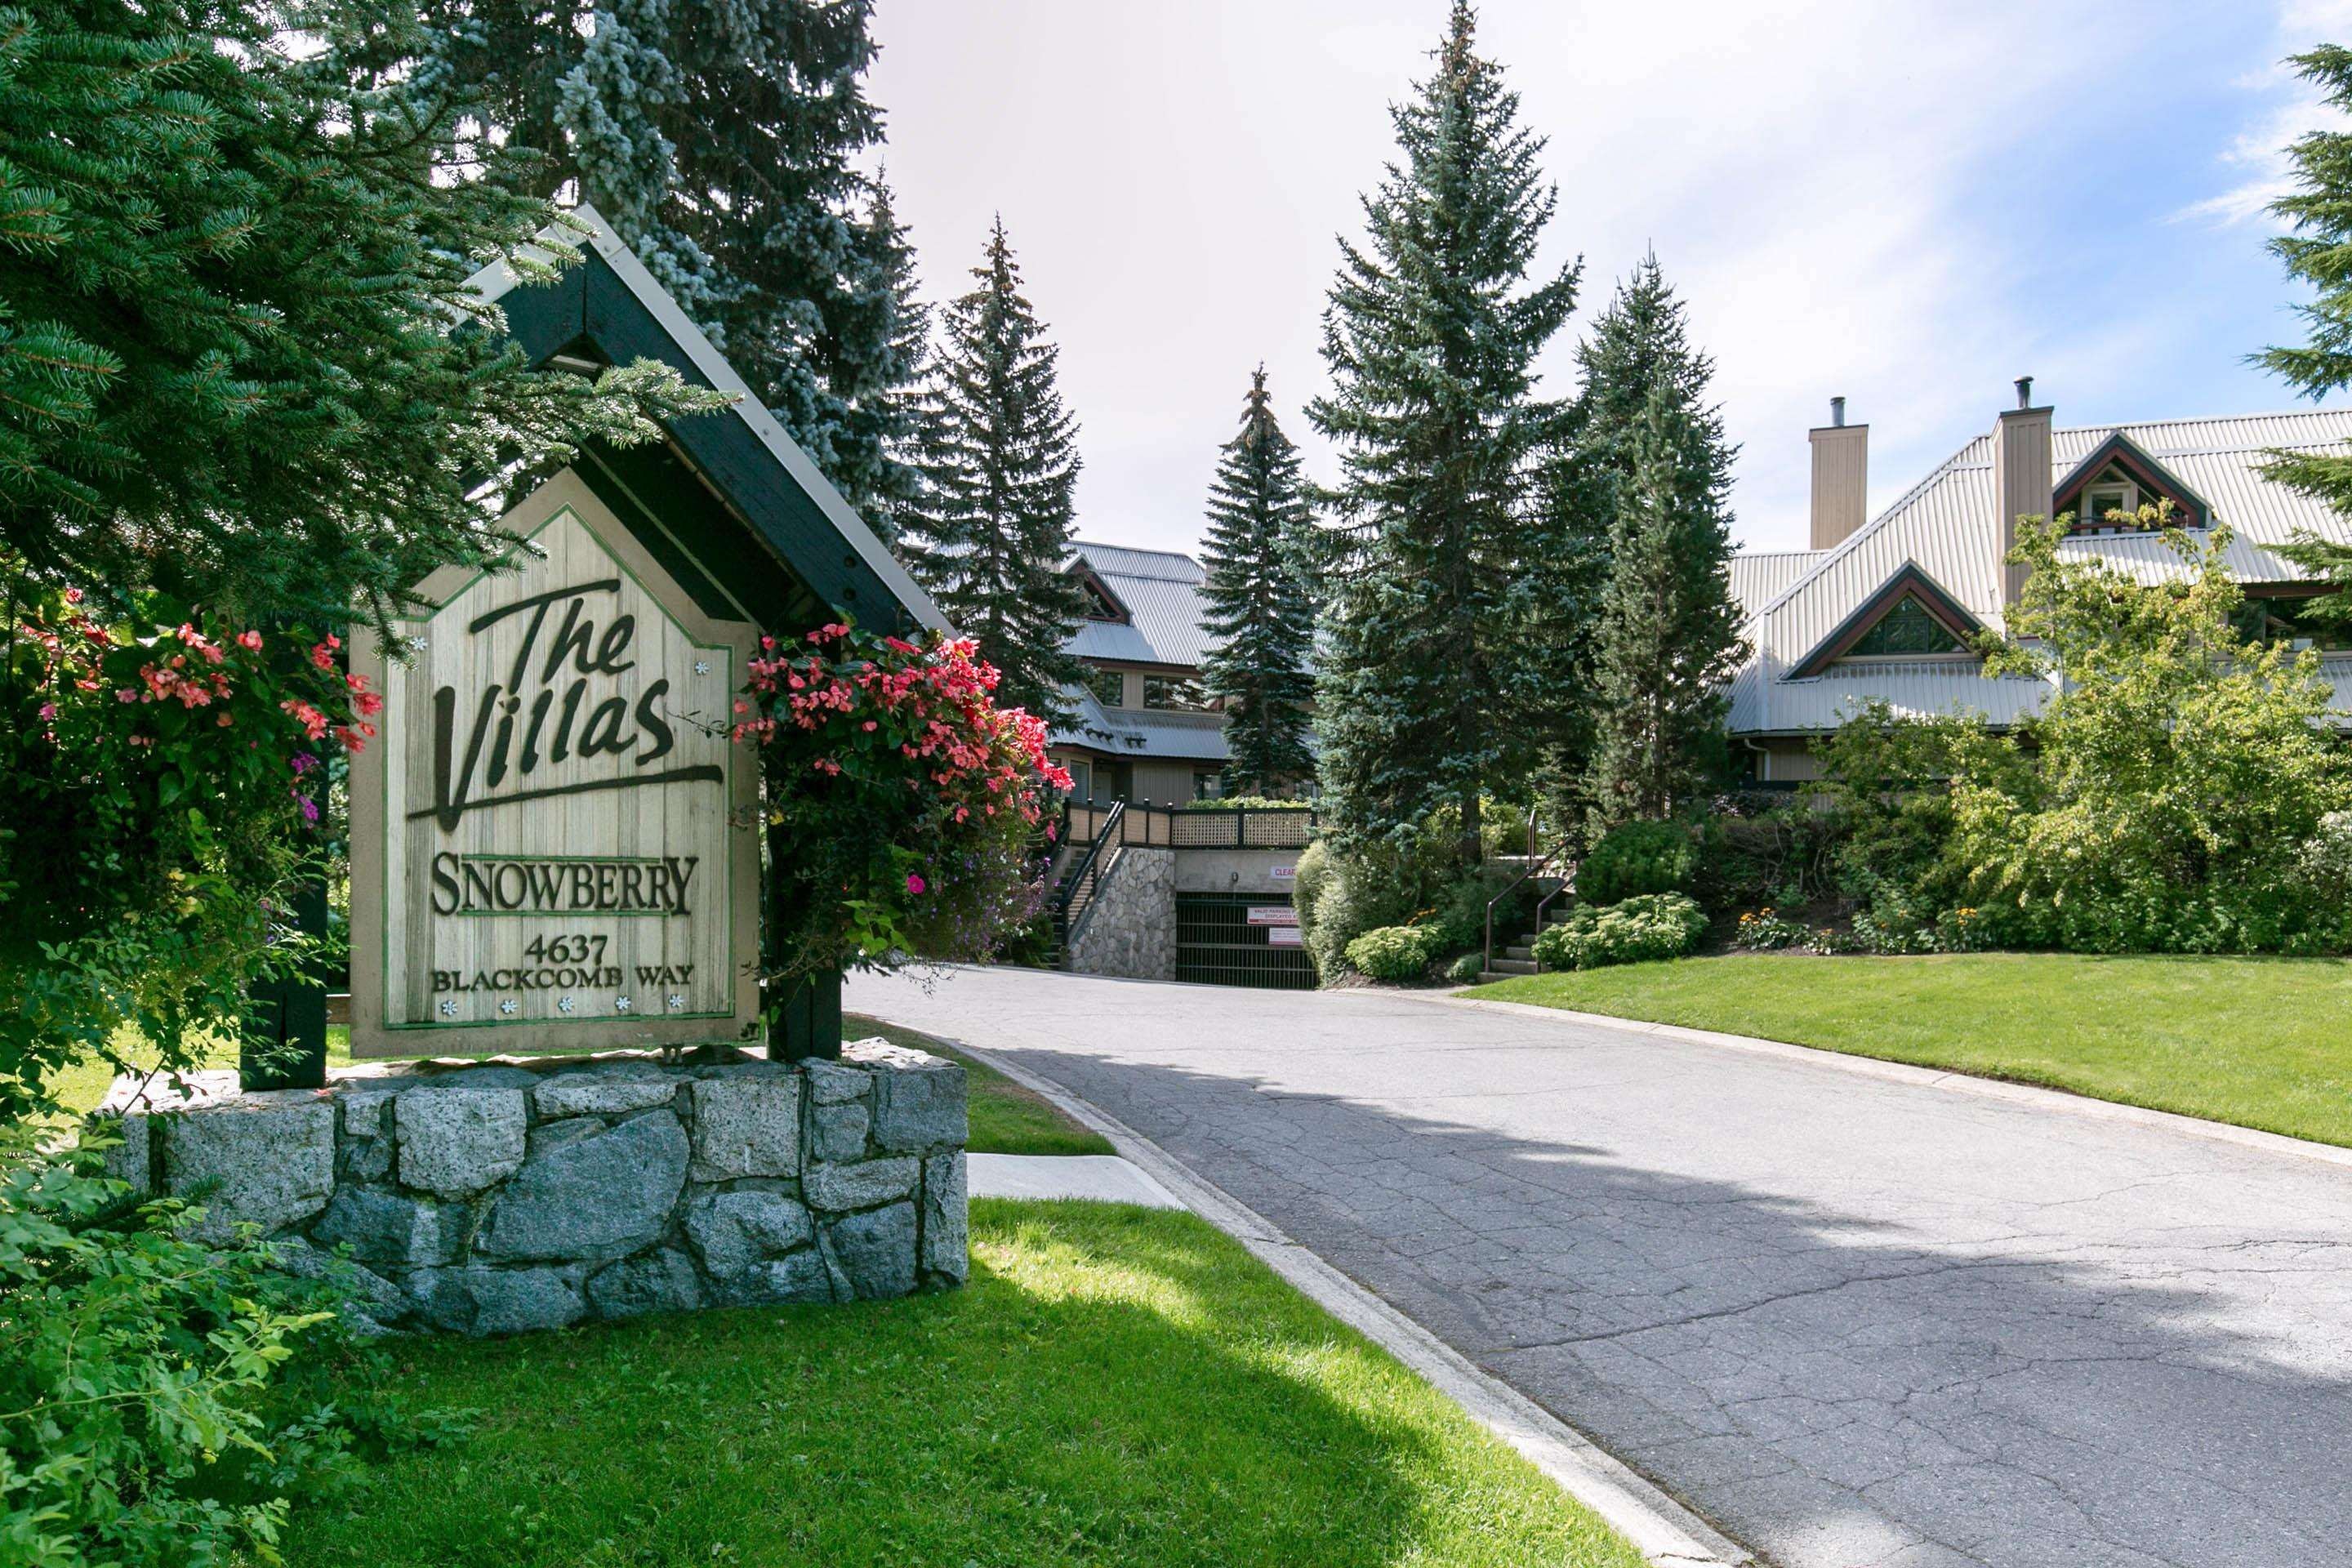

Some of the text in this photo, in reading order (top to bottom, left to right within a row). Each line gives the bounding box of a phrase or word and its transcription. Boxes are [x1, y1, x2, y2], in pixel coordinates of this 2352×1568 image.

[470, 578, 635, 693] The
[434, 678, 674, 833] Villas
[431, 852, 698, 915] SNOWBERRY
[432, 964, 694, 991] BLACKCOMB WAY
[525, 934, 608, 964] 4637
